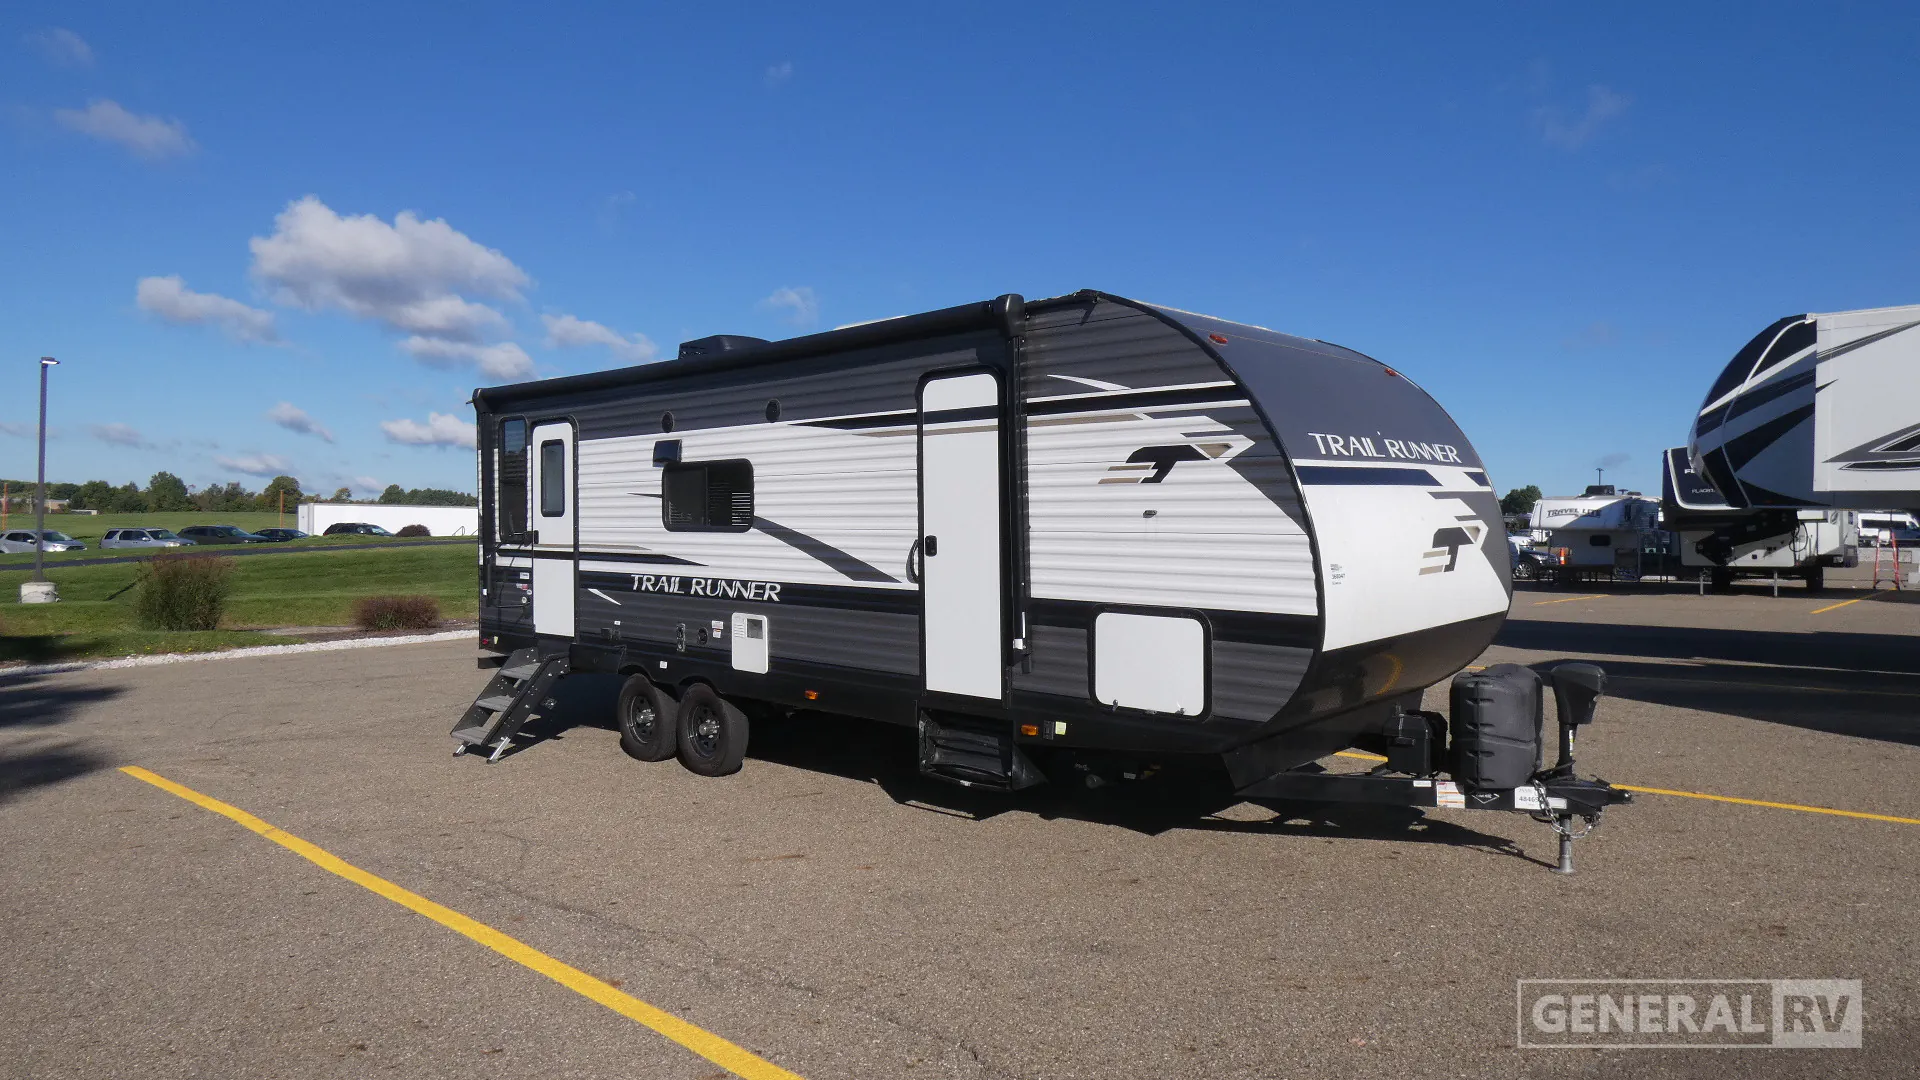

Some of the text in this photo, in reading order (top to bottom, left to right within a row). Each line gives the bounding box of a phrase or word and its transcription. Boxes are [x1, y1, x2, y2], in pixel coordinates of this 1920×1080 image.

[1307, 432, 1463, 464] TRAIL RUNNER
[1547, 508, 1579, 518] TRAVEL
[630, 574, 781, 602] TRAIL RUNNER
